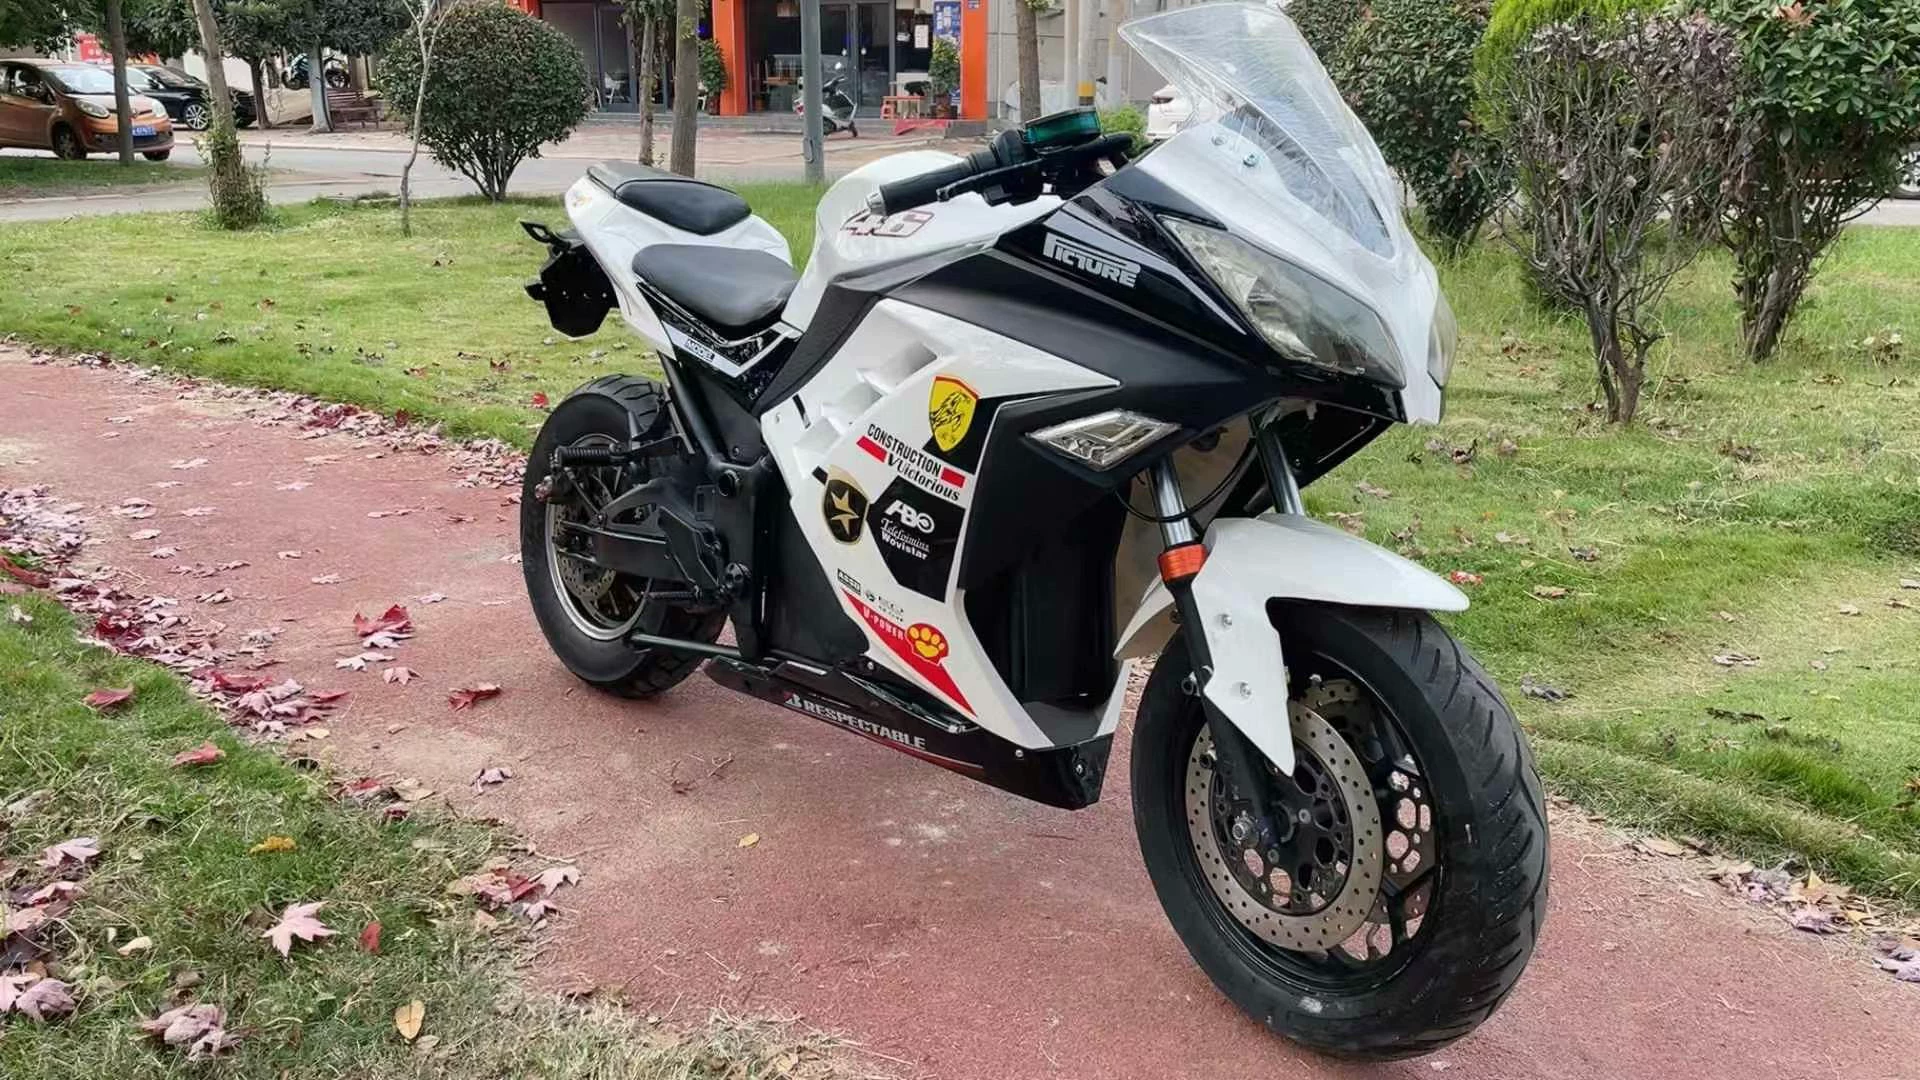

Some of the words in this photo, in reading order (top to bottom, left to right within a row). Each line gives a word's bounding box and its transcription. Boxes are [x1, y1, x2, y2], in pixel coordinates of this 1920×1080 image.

[1043, 232, 1141, 288] PICTURE
[867, 423, 942, 478] CONSTRUCTION
[803, 700, 927, 750] RESPECTABLE
